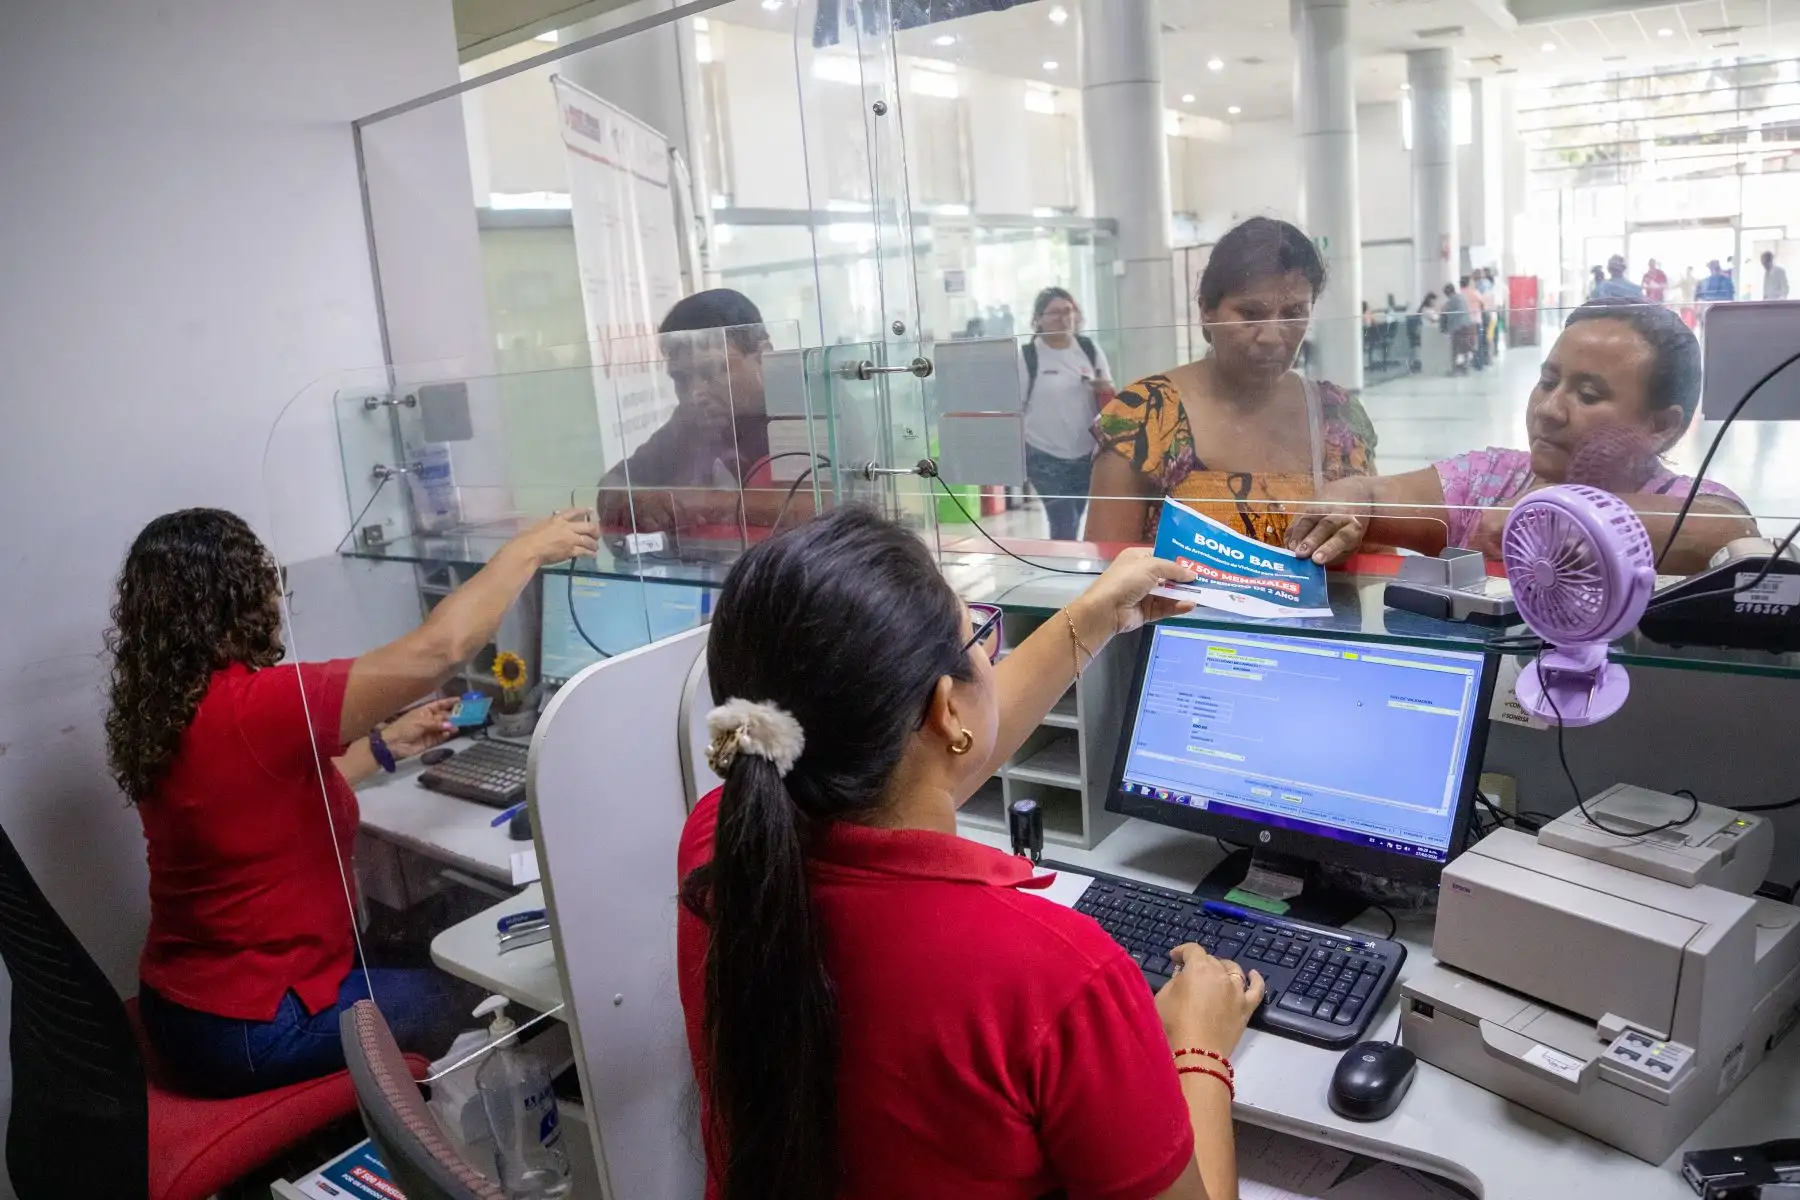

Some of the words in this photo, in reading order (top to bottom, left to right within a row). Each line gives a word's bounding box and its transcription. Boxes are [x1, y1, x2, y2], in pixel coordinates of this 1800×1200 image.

[1194, 533, 1244, 560] BONO
[1250, 555, 1284, 571] BAE
[1181, 560, 1194, 570] S/
[1195, 565, 1219, 578] 500
[1221, 573, 1298, 592] MENSUALES
[1275, 590, 1300, 602] AÑOS
[1452, 883, 1471, 894] EPSON
